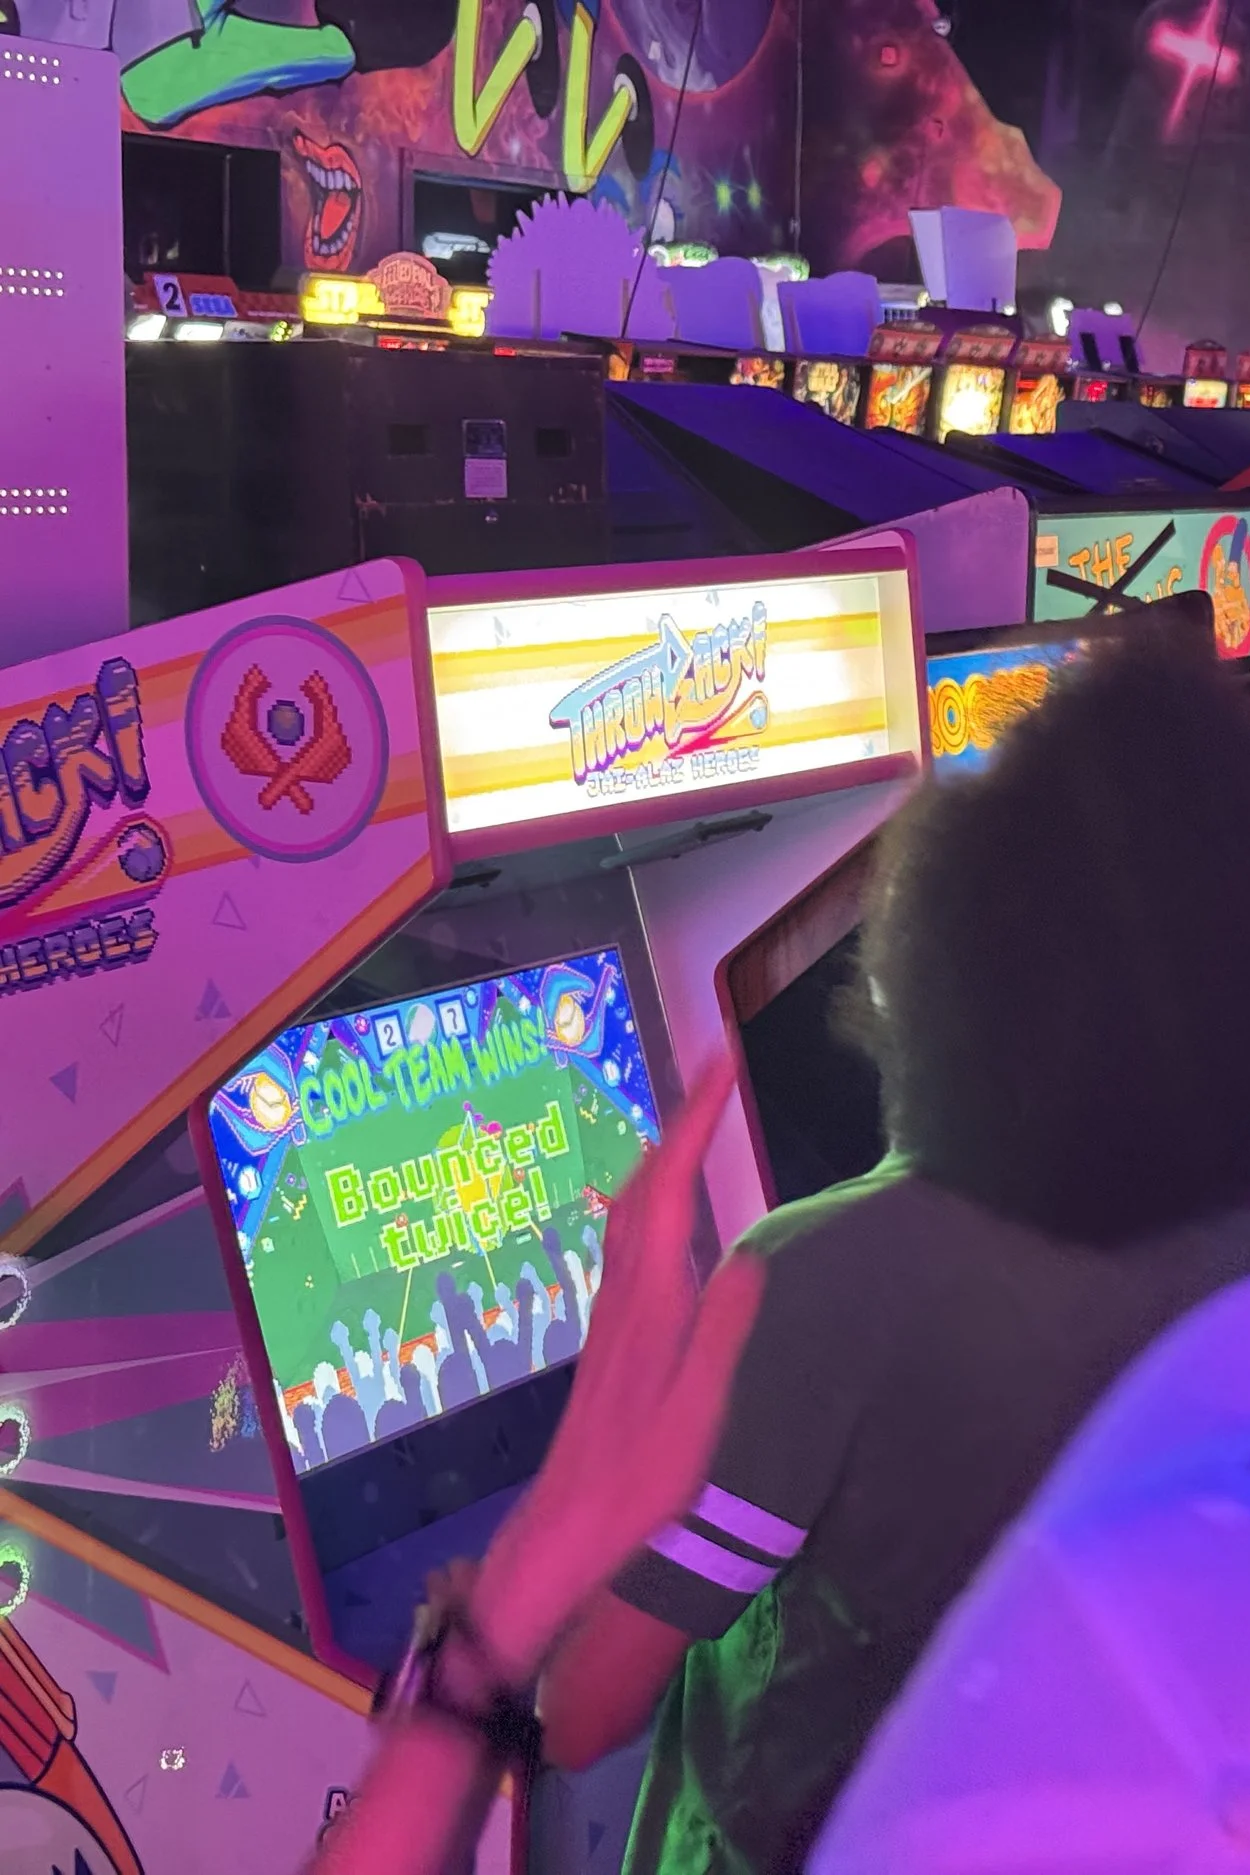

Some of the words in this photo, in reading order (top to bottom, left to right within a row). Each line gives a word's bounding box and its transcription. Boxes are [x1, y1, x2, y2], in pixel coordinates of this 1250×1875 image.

[163, 282, 180, 310] 2
[1068, 532, 1133, 589] THE
[690, 745, 761, 780] HEROES
[383, 1023, 397, 1047] 2
[301, 1060, 385, 1134] COOL
[387, 1035, 472, 1102] TEAM
[474, 1008, 548, 1082] WINS!
[325, 1101, 570, 1227] Bounced
[382, 1168, 554, 1273] twice!
